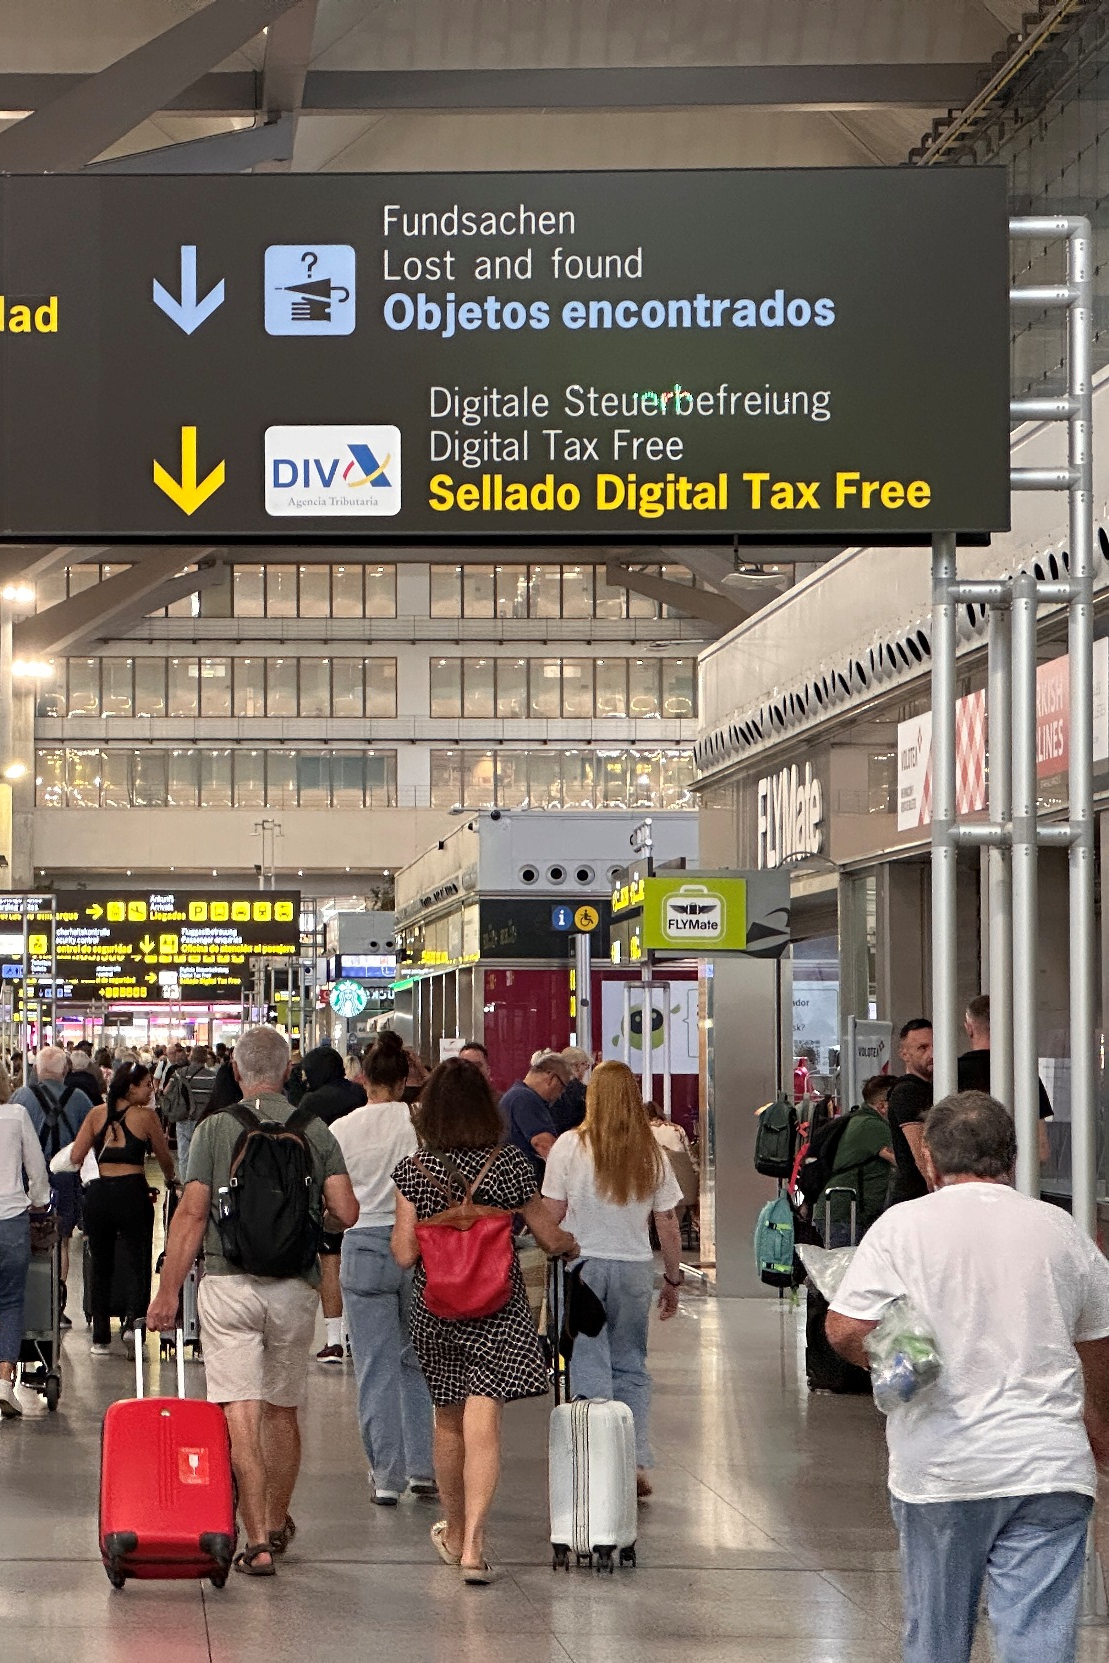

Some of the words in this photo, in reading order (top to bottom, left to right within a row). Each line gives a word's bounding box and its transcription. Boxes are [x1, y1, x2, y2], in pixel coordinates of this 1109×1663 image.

[383, 203, 575, 237] Fundsachen
[383, 249, 456, 281] Lost
[474, 247, 532, 281] and
[551, 246, 643, 280] found
[383, 292, 550, 339] Objetos
[561, 288, 836, 330] encontrados
[430, 385, 549, 427] Digitale
[564, 383, 831, 422] Steuerbefreiung
[430, 429, 529, 469] Digital
[542, 429, 600, 461] Tax
[613, 429, 684, 461] Free
[288, 497, 327, 508] Agencia
[329, 496, 379, 506] Tributaria
[428, 473, 581, 512] Sellado
[596, 472, 728, 519] Digital
[742, 472, 821, 510] Tax
[835, 471, 932, 509] Free
[1036, 718, 1064, 763] LINES
[757, 761, 823, 870] FLYMate
[668, 918, 719, 931] FLYMate
[56, 944, 80, 954] ontrol
[858, 1046, 880, 1058] VOLOTEA
